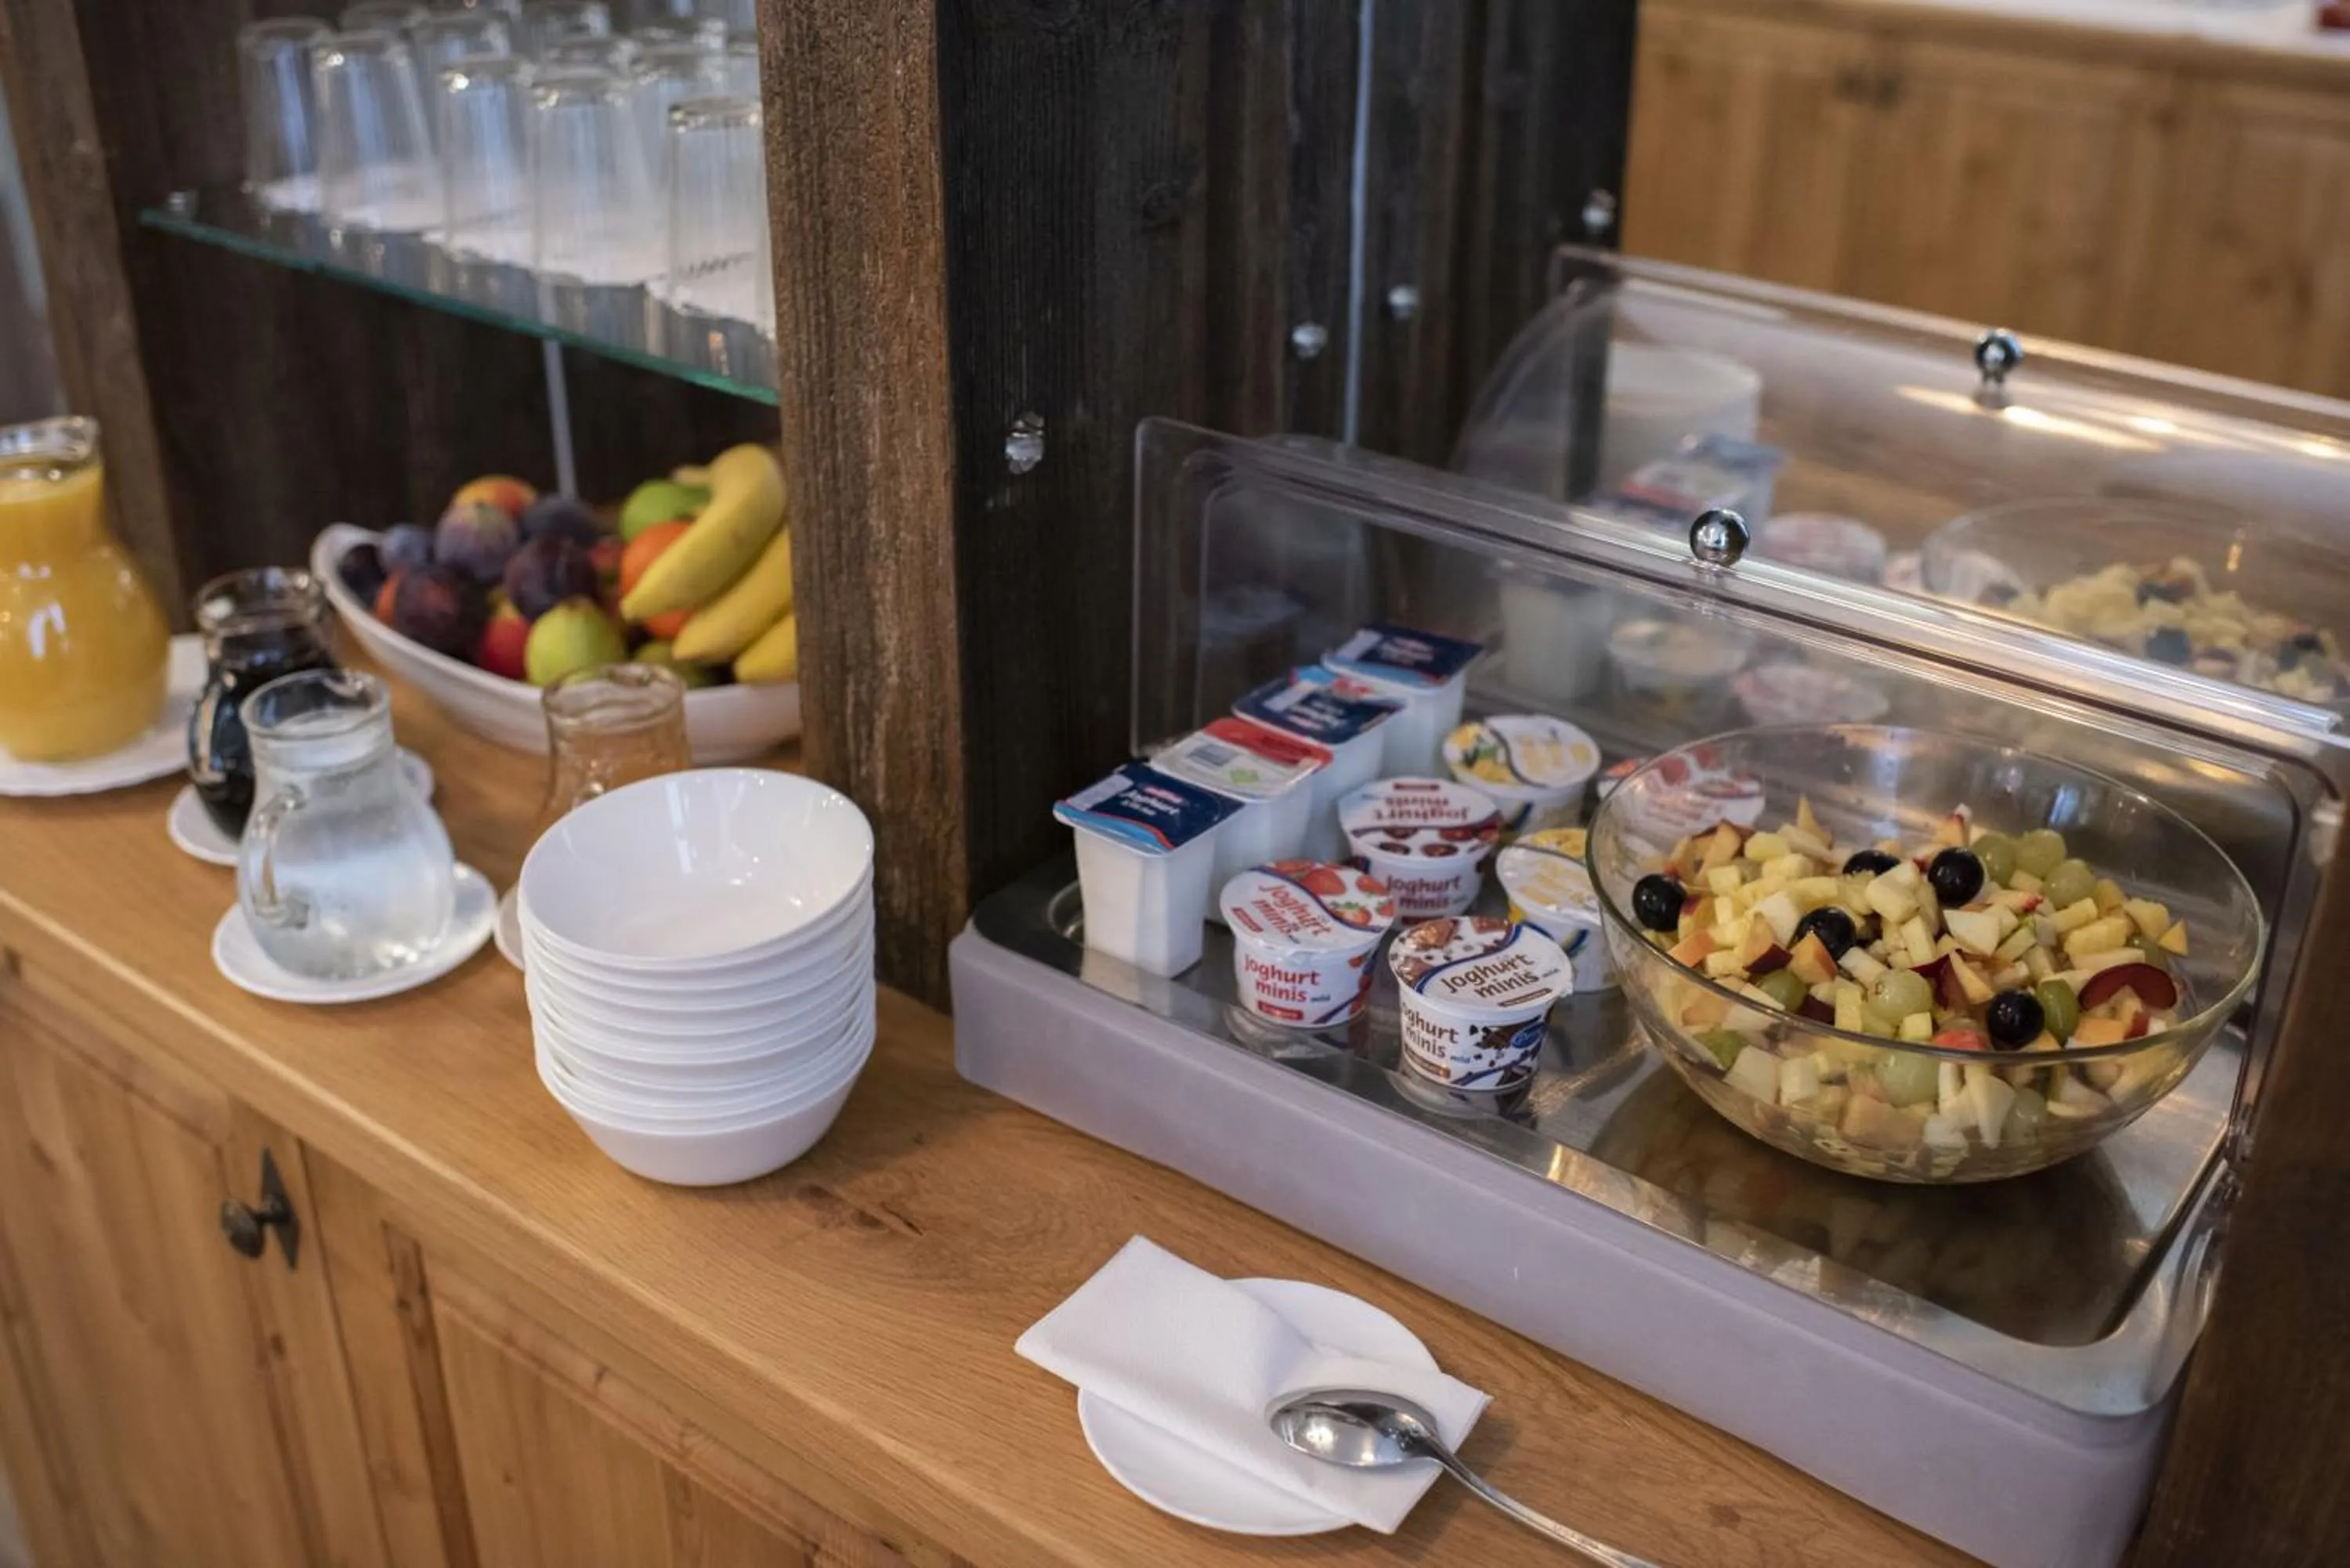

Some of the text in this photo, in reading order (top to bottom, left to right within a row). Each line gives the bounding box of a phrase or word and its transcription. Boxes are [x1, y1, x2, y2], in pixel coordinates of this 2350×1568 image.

[1386, 874, 1462, 896] Joghurt
[1257, 883, 1332, 936] Joghurt
[1245, 954, 1321, 986] Joghurt
[1440, 952, 1535, 994] Joghurt
[1474, 970, 1539, 999] minis
[1256, 980, 1307, 1003] minis
